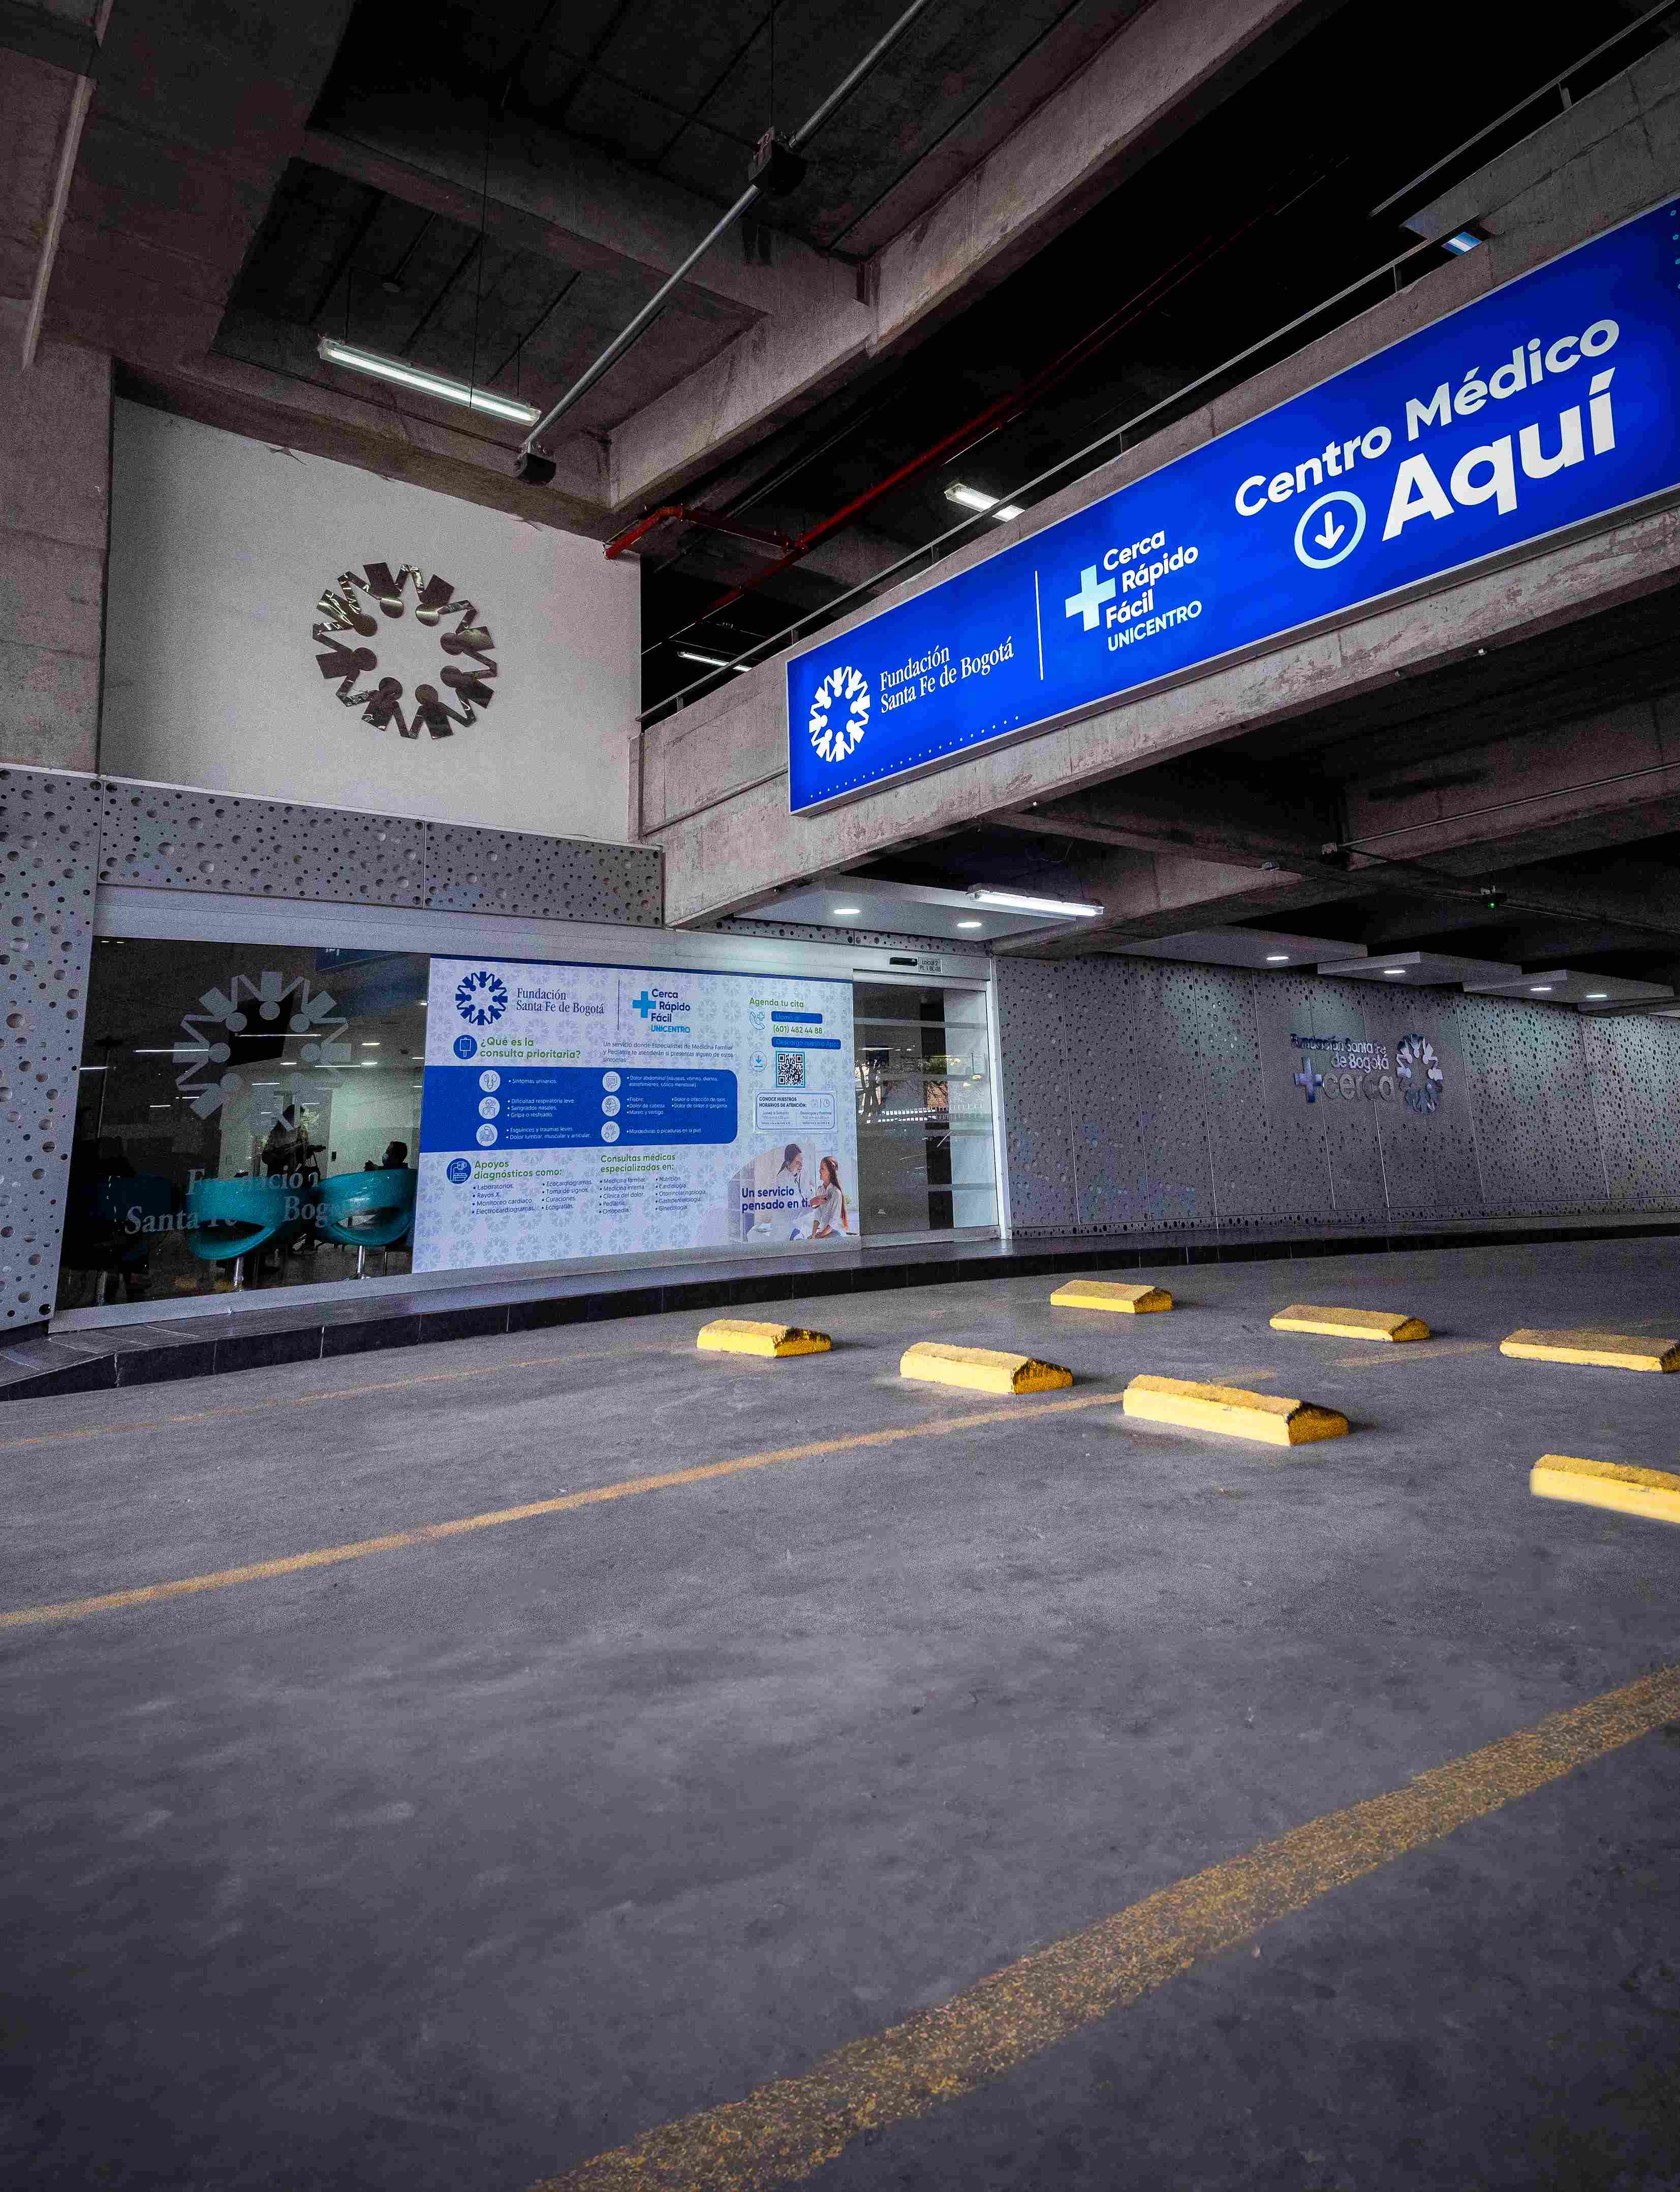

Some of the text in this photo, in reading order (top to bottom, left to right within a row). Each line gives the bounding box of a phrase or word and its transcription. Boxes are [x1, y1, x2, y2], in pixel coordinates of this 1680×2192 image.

[1235, 319, 1620, 516] Centro Médico
[1382, 366, 1616, 542] Aquí
[1103, 530, 1165, 570] Cerca
[1122, 546, 1198, 593] Rápido
[1106, 589, 1154, 629] Fácil
[1108, 600, 1202, 651] UNICENTRO
[880, 645, 950, 692] Fundación
[881, 636, 1014, 714] Santa Fe de Bogotá
[516, 987, 567, 1001] Fundación
[651, 989, 678, 999] Cerca
[516, 1000, 605, 1016] Santa Fe de Bogotá
[659, 1001, 691, 1012] Rápido
[749, 997, 779, 1007] Agenda
[790, 1000, 804, 1008] cita
[650, 1012, 672, 1023] Fácil
[650, 1025, 691, 1033] UNICENTRO
[773, 1024, 789, 1033] (601)
[480, 1037, 508, 1047] ¿Qué
[525, 1037, 534, 1046] la
[1291, 1033, 1344, 1051] Fundación
[1346, 1038, 1373, 1054] Santa
[480, 1048, 581, 1060] consulta prioritaria?
[1331, 1052, 1390, 1074] de Bogotá
[1322, 1072, 1396, 1103] cerca
[601, 1153, 675, 1162] Consultas médicas
[474, 1160, 509, 1170] Apoyos
[601, 1164, 660, 1174] especializadas
[474, 1168, 562, 1180] diagnósticos como:
[741, 1186, 794, 1198] Un servicio
[742, 1199, 810, 1214] pensado en ti.
[124, 1206, 200, 1234] Santa
